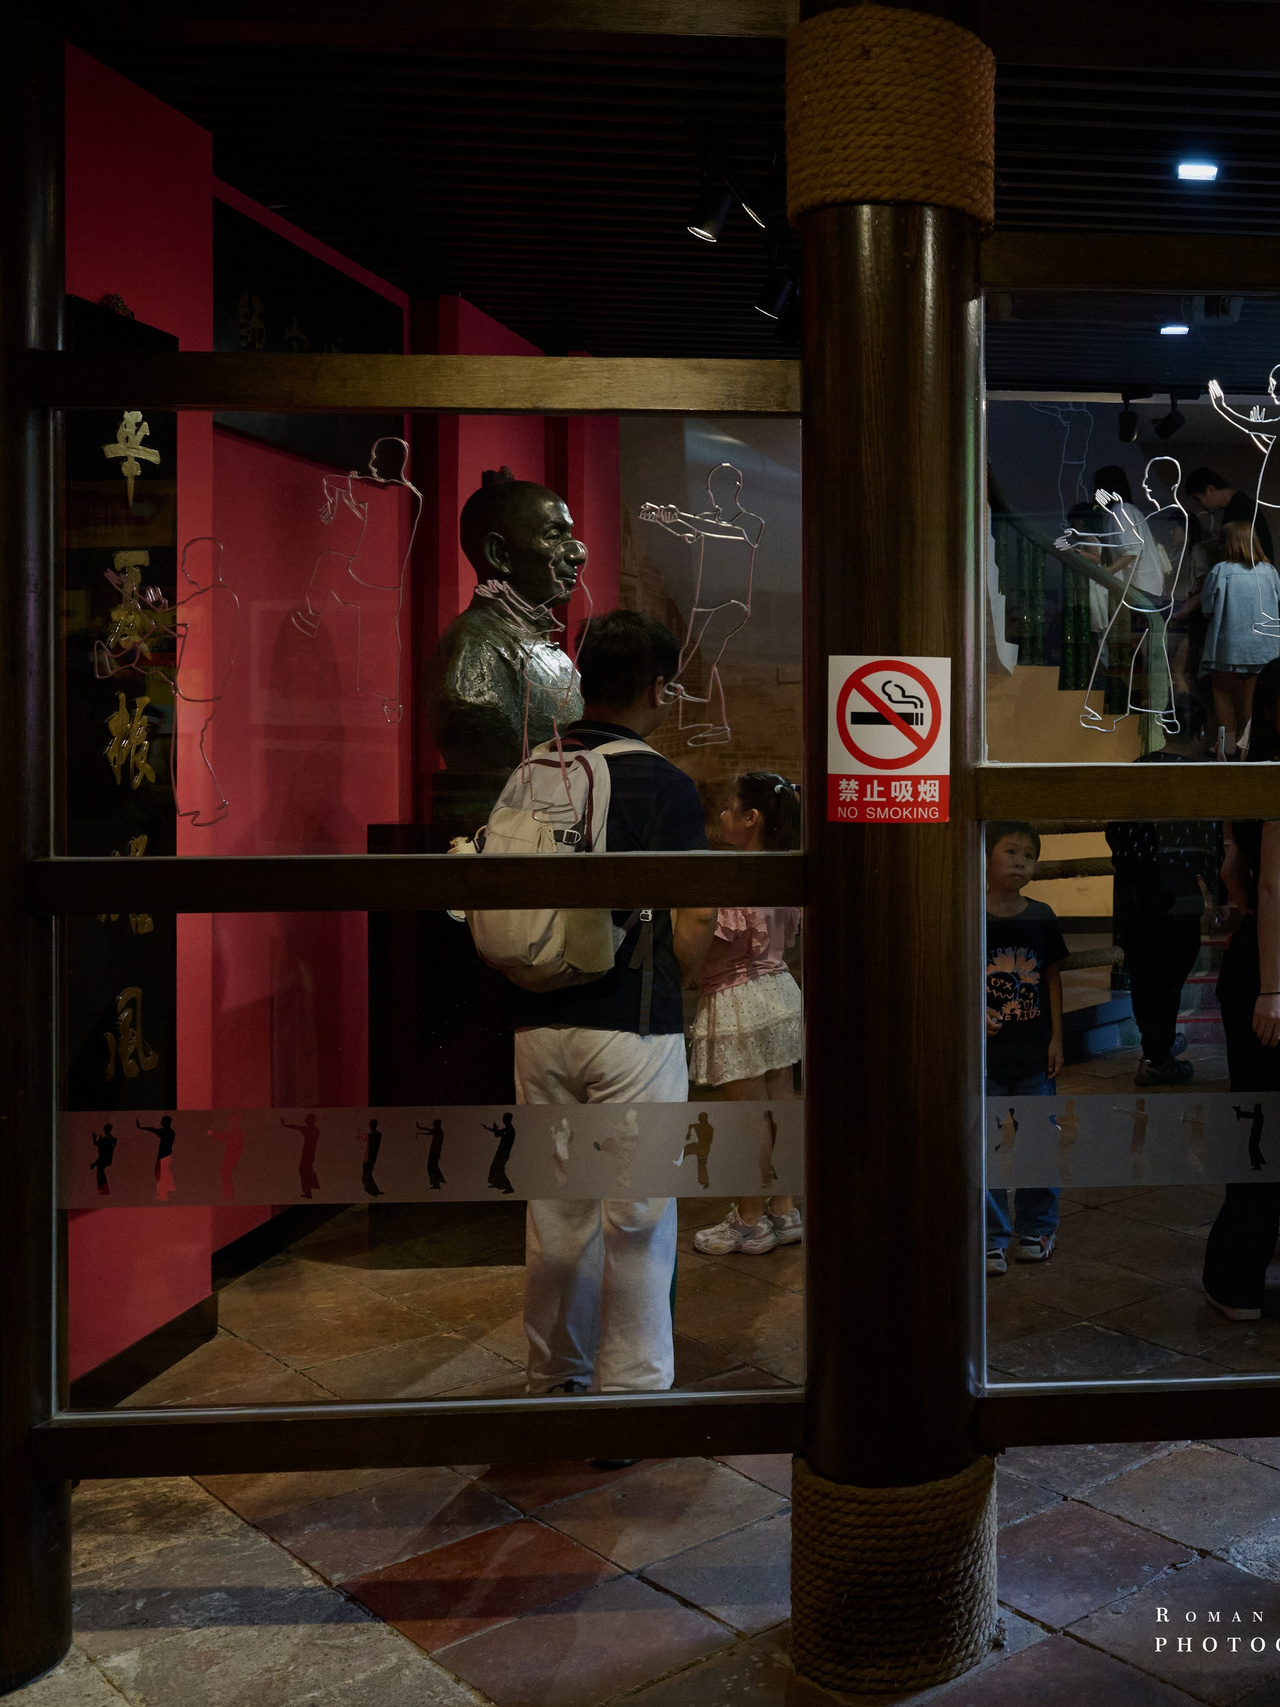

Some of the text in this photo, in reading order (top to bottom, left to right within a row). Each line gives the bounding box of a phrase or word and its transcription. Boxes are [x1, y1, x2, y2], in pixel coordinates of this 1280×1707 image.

[838, 778, 940, 803] 禁止吸烟
[837, 806, 939, 820] NO SMOKING
